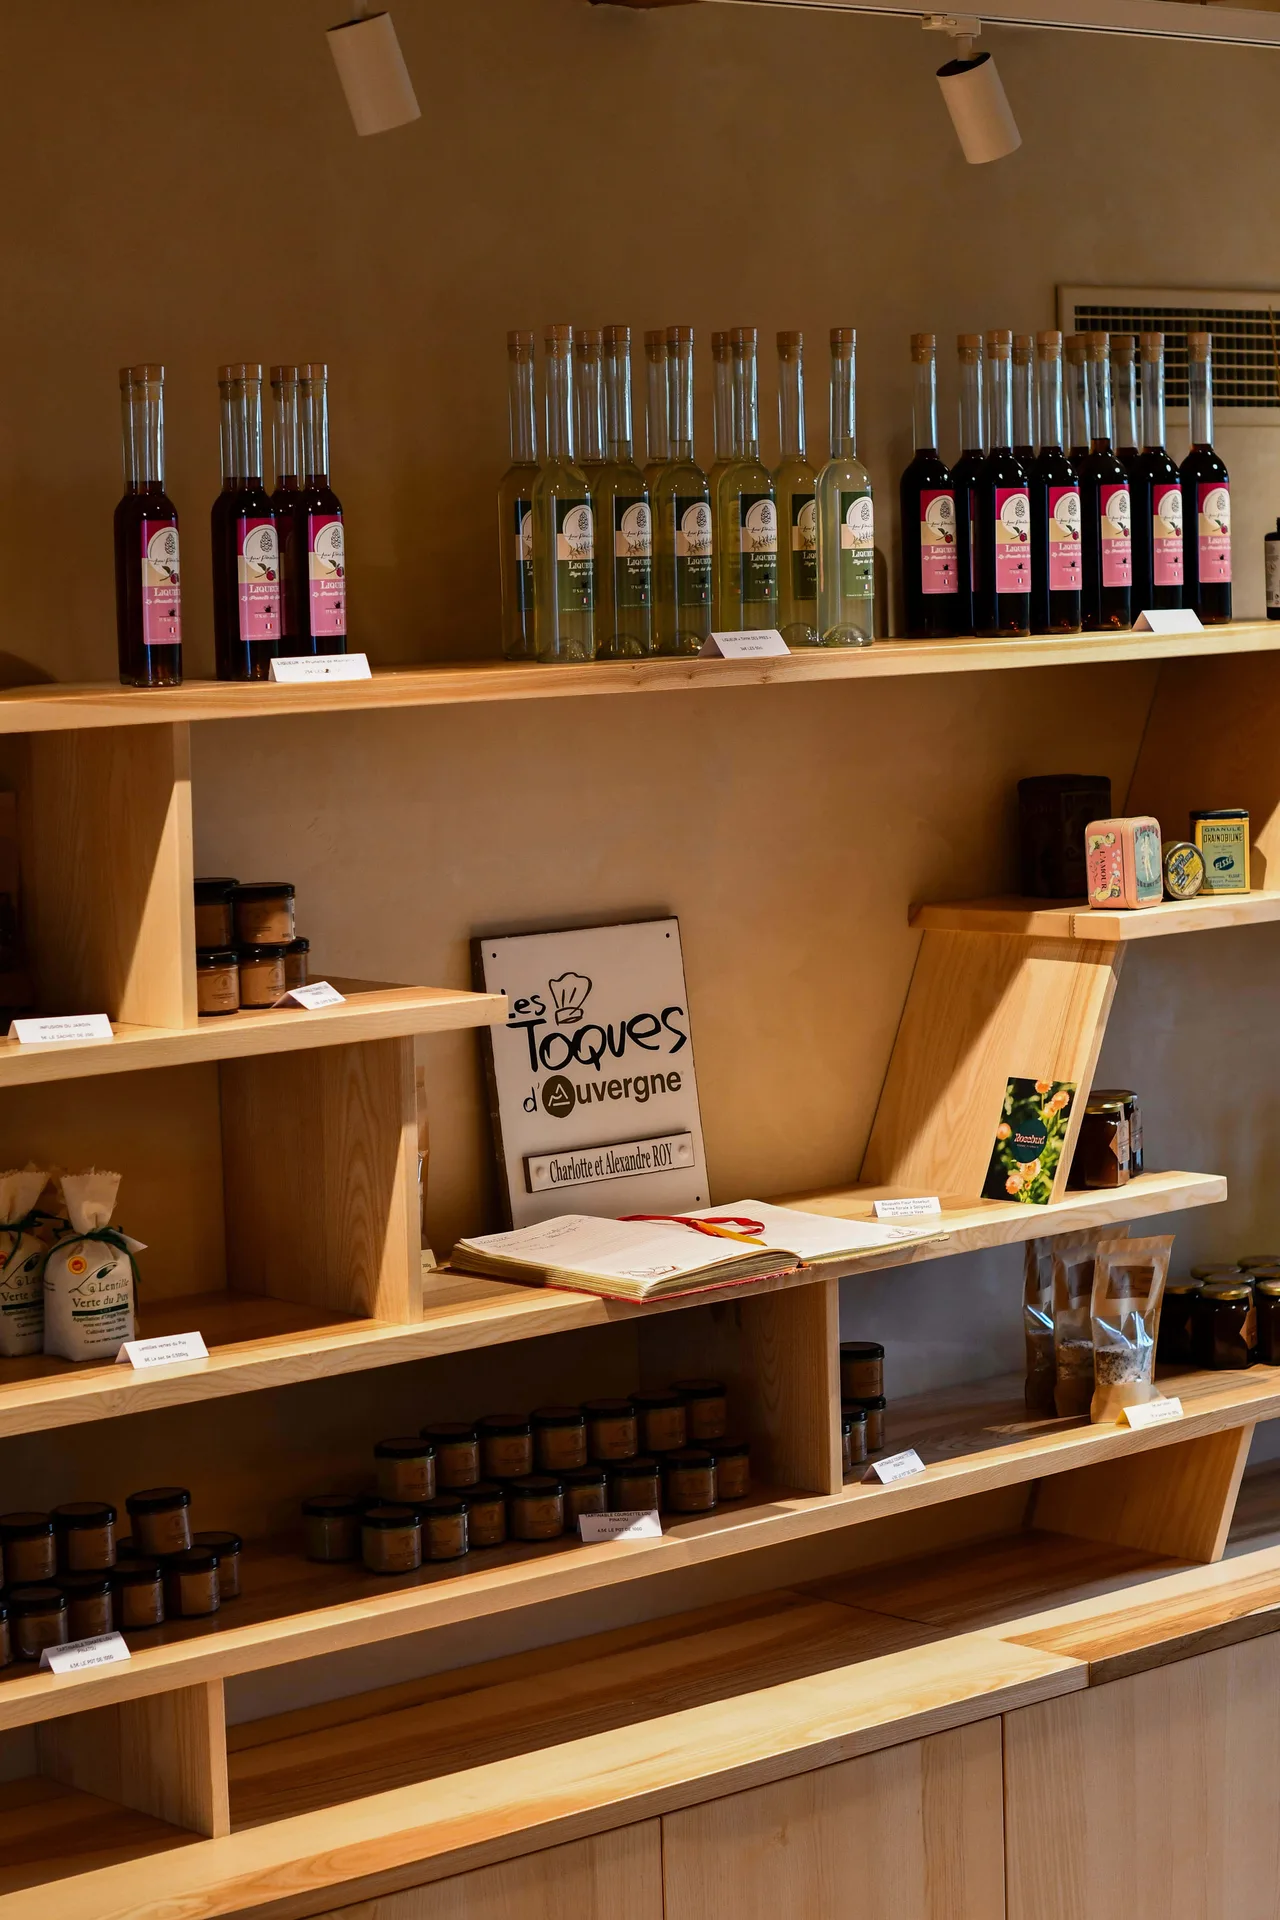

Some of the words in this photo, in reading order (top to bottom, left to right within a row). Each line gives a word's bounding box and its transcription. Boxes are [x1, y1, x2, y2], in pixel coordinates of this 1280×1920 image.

[1014, 1133, 1046, 1145] Rosebud
[549, 1158, 594, 1183] Charlotte
[594, 1159, 604, 1176] et
[605, 1146, 651, 1174] Alexandre
[652, 1143, 673, 1166] ROY
[98, 1278, 130, 1292] Lentille
[1, 1291, 28, 1301] Verte
[72, 1297, 101, 1308] Verte
[103, 1295, 114, 1305] du
[116, 1293, 129, 1303] Puy
[56, 1642, 84, 1653] TARTINABLE
[84, 1638, 102, 1647] TOMATE
